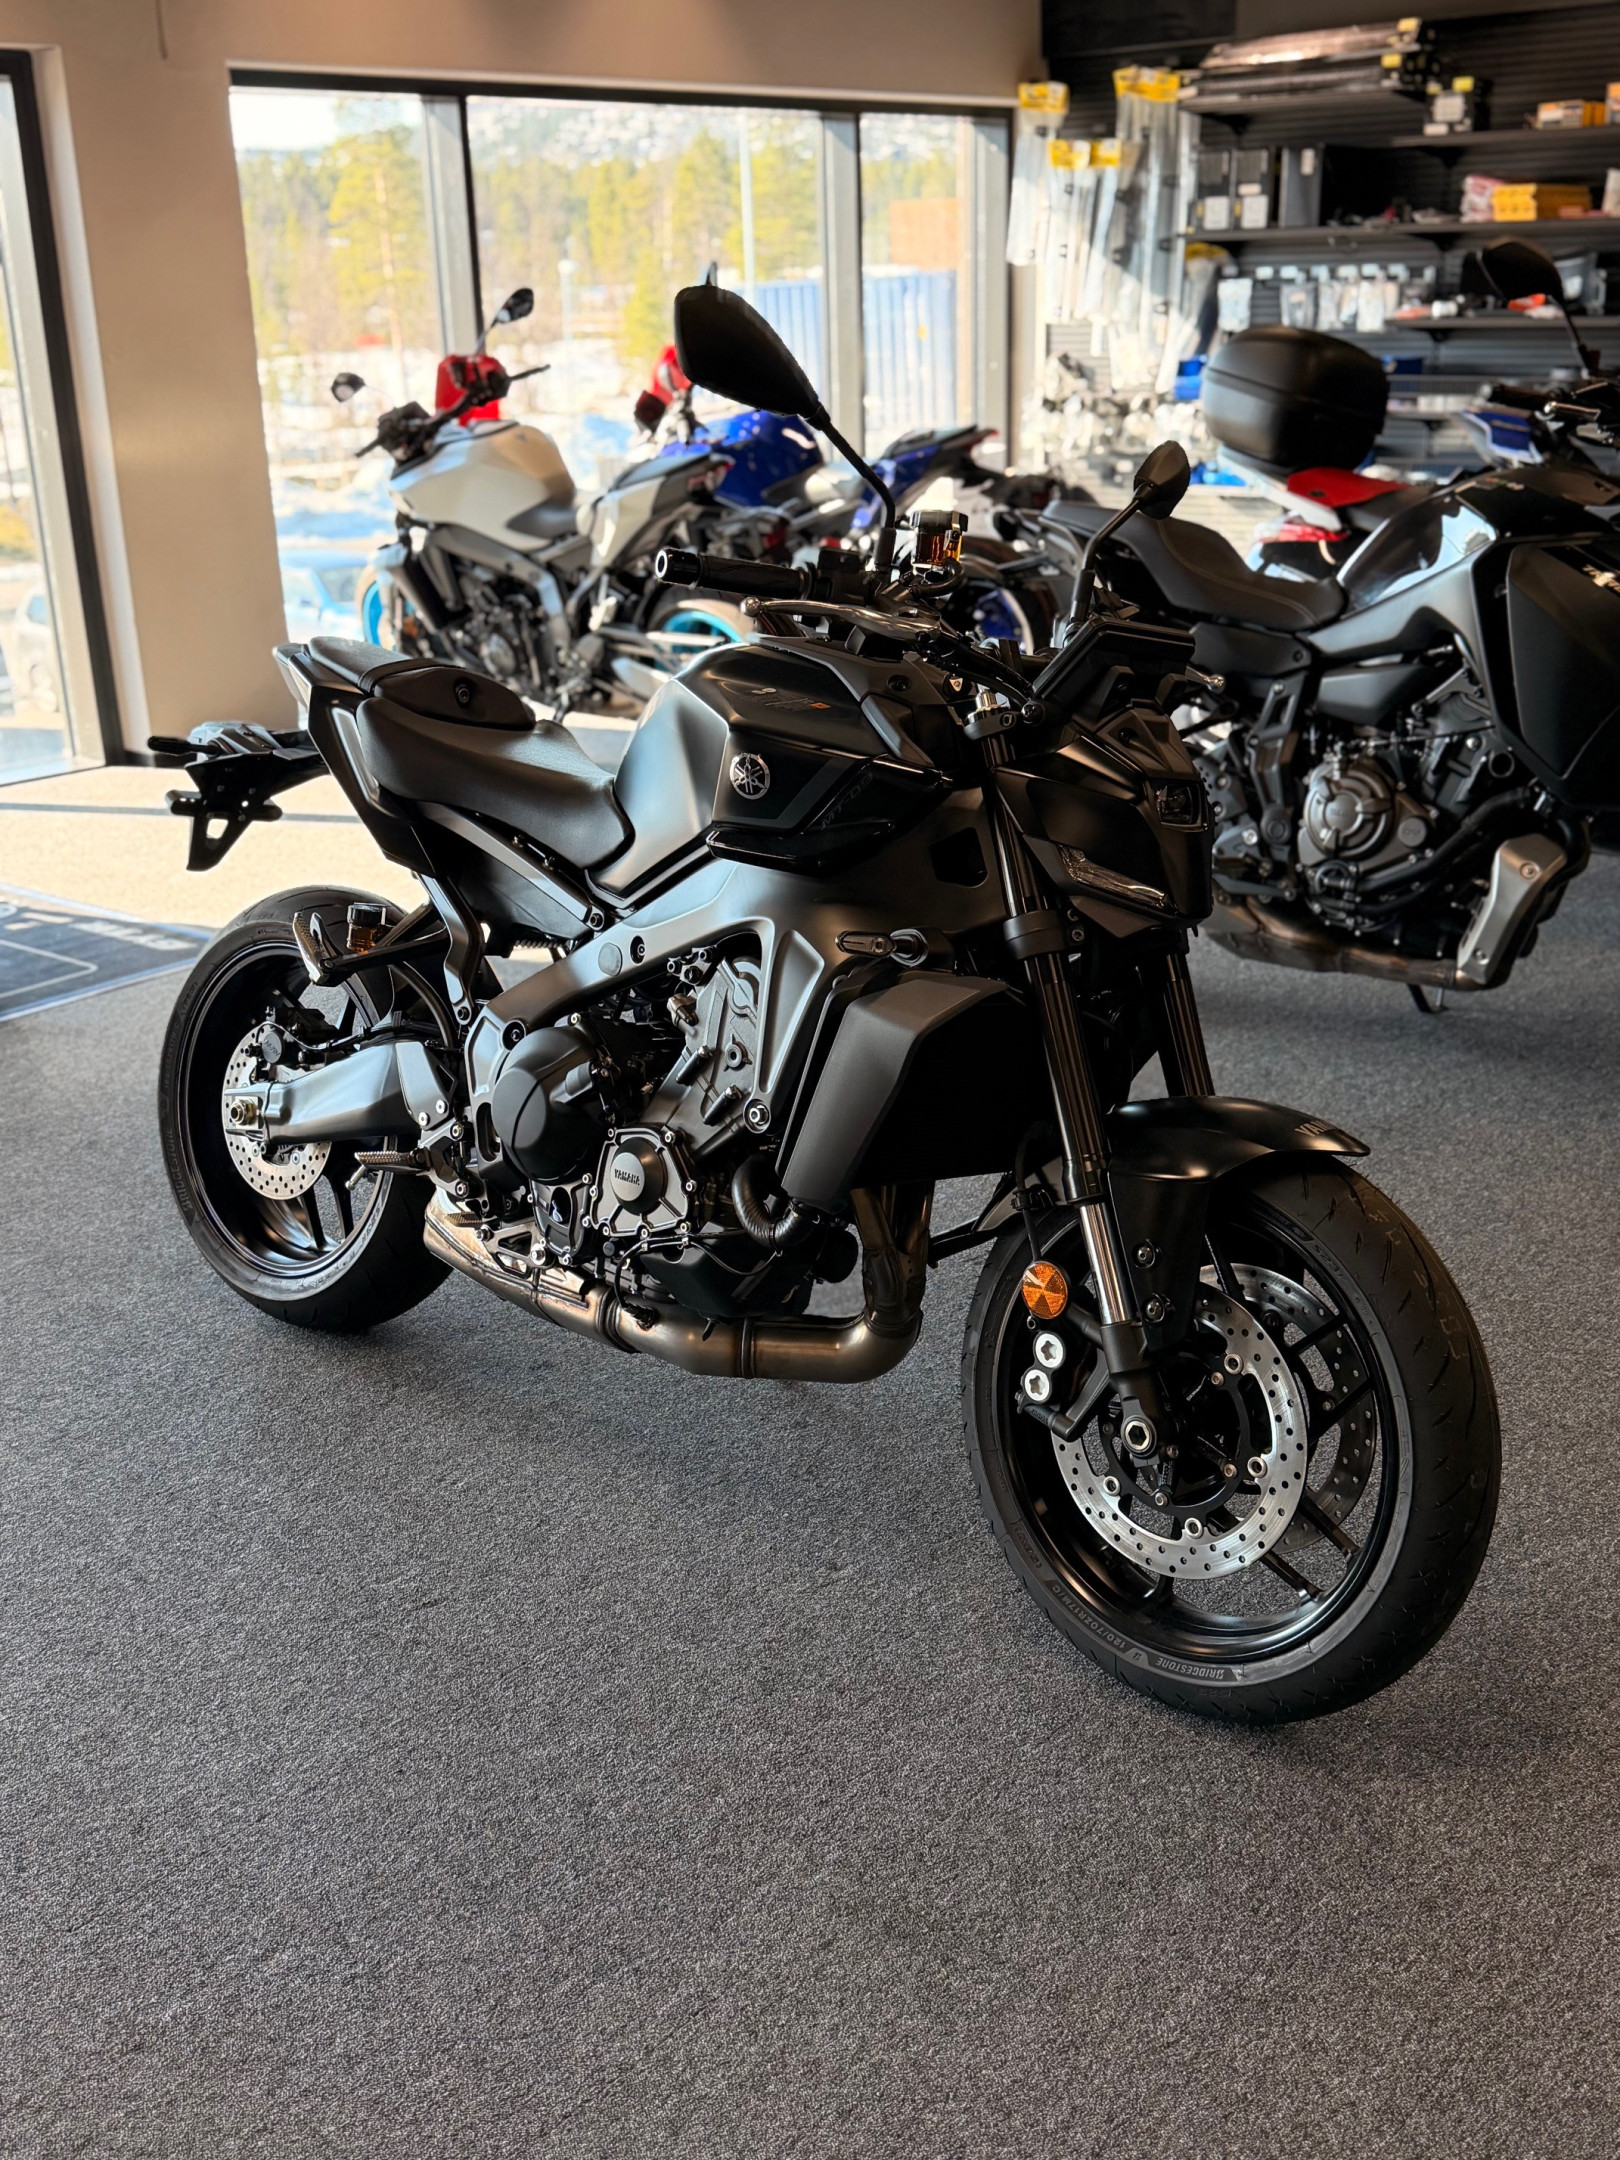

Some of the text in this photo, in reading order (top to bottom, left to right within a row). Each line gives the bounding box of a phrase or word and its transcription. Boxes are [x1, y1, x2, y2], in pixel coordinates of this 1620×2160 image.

[165, 1127, 194, 1211] BRIDGESTONE
[614, 1168, 640, 1186] YAMAHA
[1052, 1585, 1125, 1649] 120/70ZR17M/C
[1156, 1657, 1225, 1680] BRIDGESTONE
